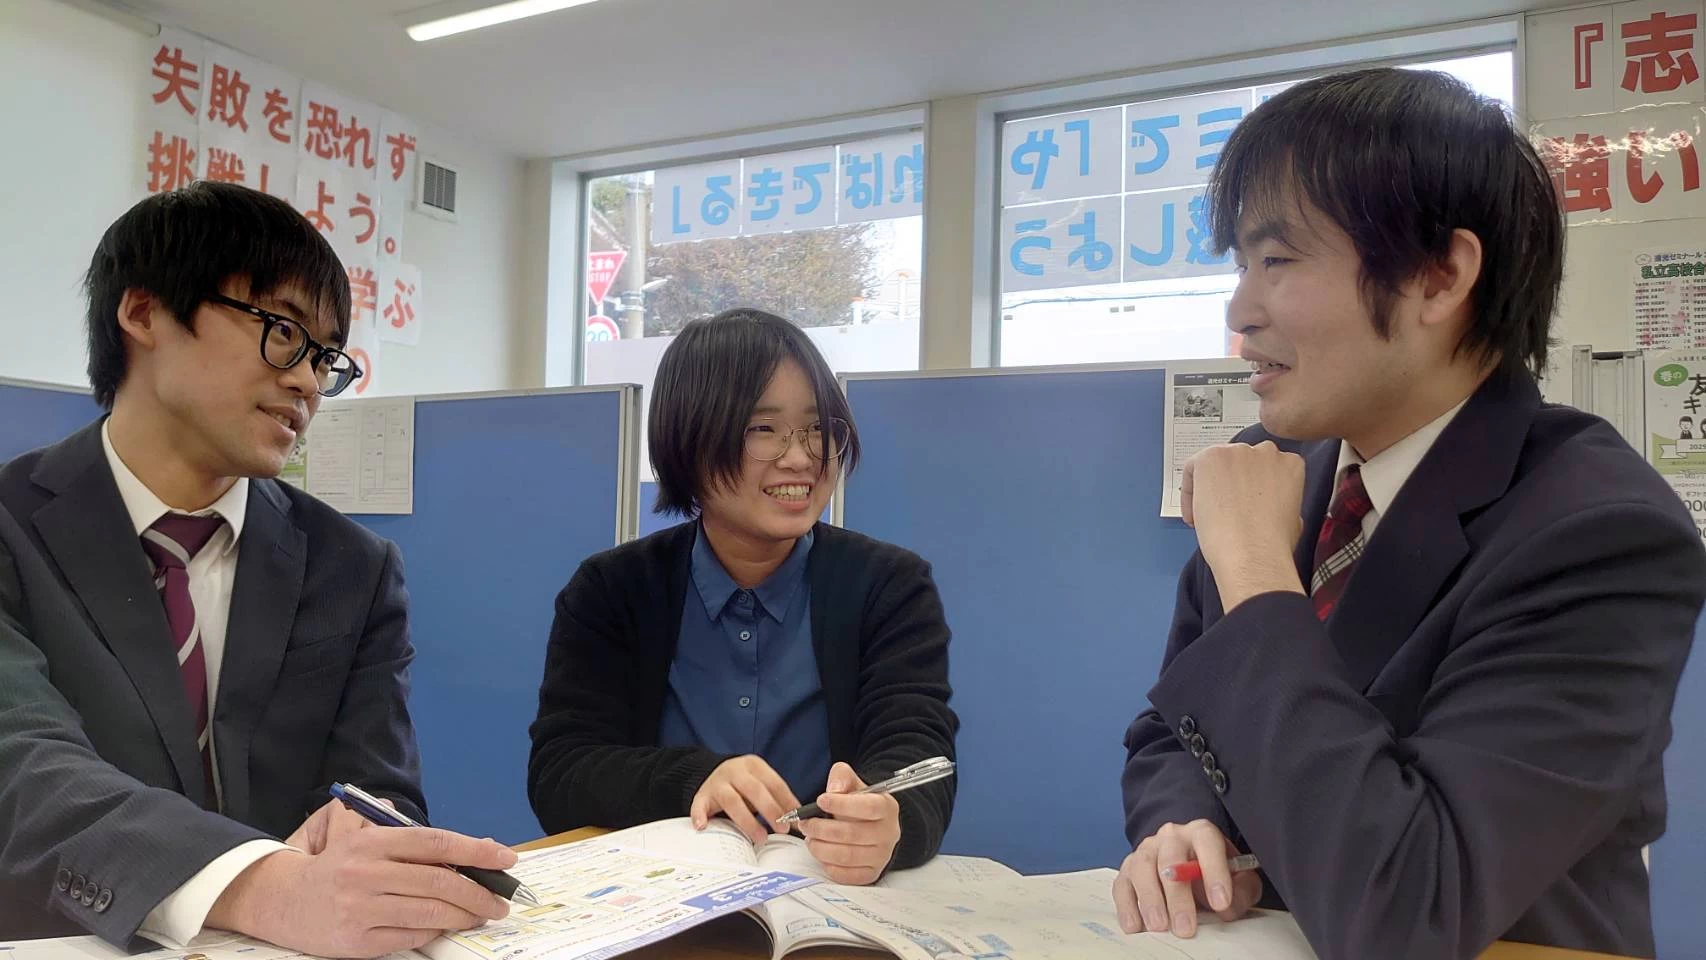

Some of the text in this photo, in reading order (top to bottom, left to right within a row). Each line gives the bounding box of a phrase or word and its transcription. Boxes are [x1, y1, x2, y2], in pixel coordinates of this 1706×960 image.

[1574, 11, 1699, 93] 『志
[152, 45, 416, 182] 失敗を恐れず
[1542, 131, 1700, 213] 強い
[1641, 261, 1706, 279] 私立高校合
